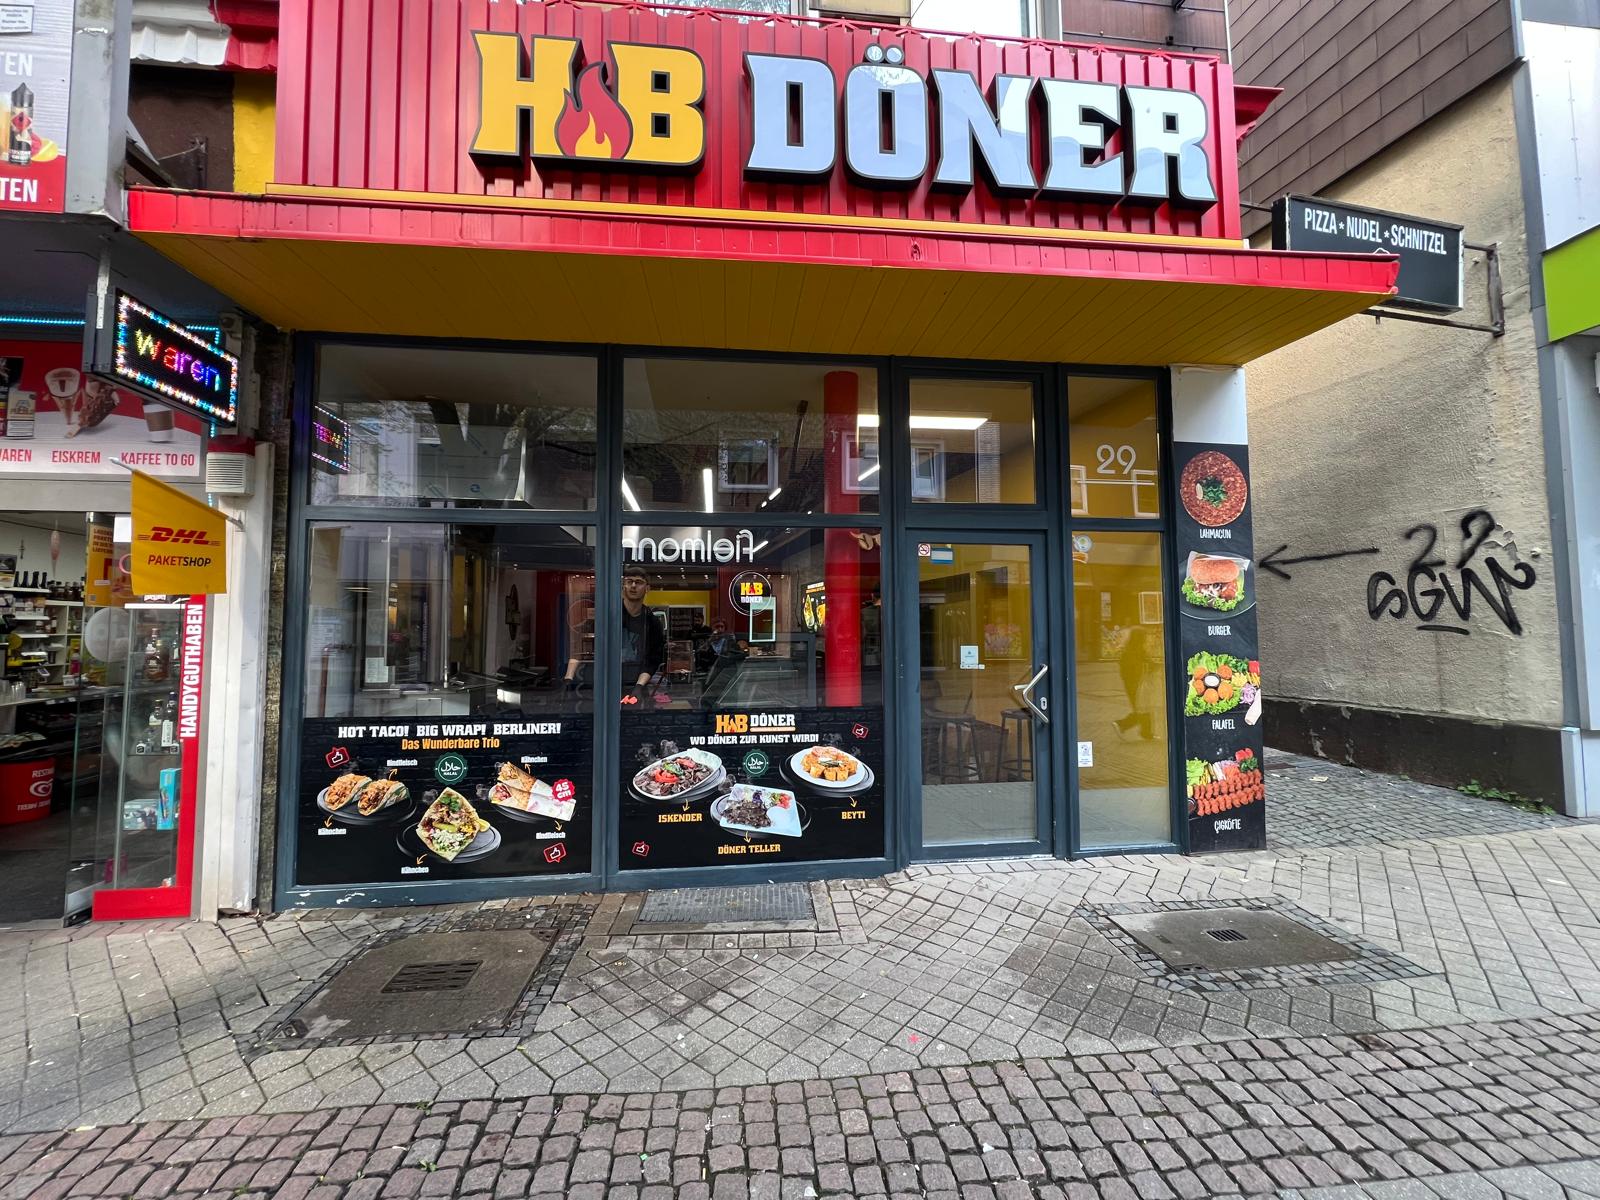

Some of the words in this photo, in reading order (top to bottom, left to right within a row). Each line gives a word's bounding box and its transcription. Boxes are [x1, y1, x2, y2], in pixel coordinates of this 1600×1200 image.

[0, 52, 33, 77] EN
[744, 42, 1217, 202] DÖNER
[1304, 207, 1337, 235] PIZZA
[1346, 216, 1382, 243] NUDEL
[1390, 224, 1447, 255] SCHNITZEL
[51, 450, 101, 463] EISKREM
[120, 452, 161, 465] KAFFEE
[165, 453, 178, 466] TO
[180, 453, 195, 466] GO
[1096, 444, 1137, 475] 29
[150, 526, 210, 545] DHL
[1199, 529, 1232, 540] LAHMACUN
[147, 554, 212, 567] PAKETSHOP
[1207, 625, 1232, 636] BURGER
[179, 604, 204, 738] HANDYGUTHABEN
[750, 713, 796, 728] DÖNER
[1211, 719, 1236, 731] FALAFEL
[338, 726, 366, 739] HOT
[369, 725, 410, 738] TACO!
[416, 724, 439, 737] BIG
[442, 723, 487, 737] WRAP!
[493, 722, 562, 736] BERLINER!
[401, 738, 420, 750] Das
[422, 737, 480, 750] Wunderbare
[482, 737, 500, 749] Trio
[690, 736, 706, 746] WO
[707, 735, 738, 746] DÖNER
[739, 735, 757, 745] ZUR
[759, 735, 791, 745] KUNST
[555, 782, 570, 793] 45
[557, 791, 572, 799] cm
[658, 813, 703, 823] ISKENDER
[841, 810, 866, 820] BEYTI
[717, 844, 747, 855] DÖNER
[749, 843, 780, 854] TELLER
